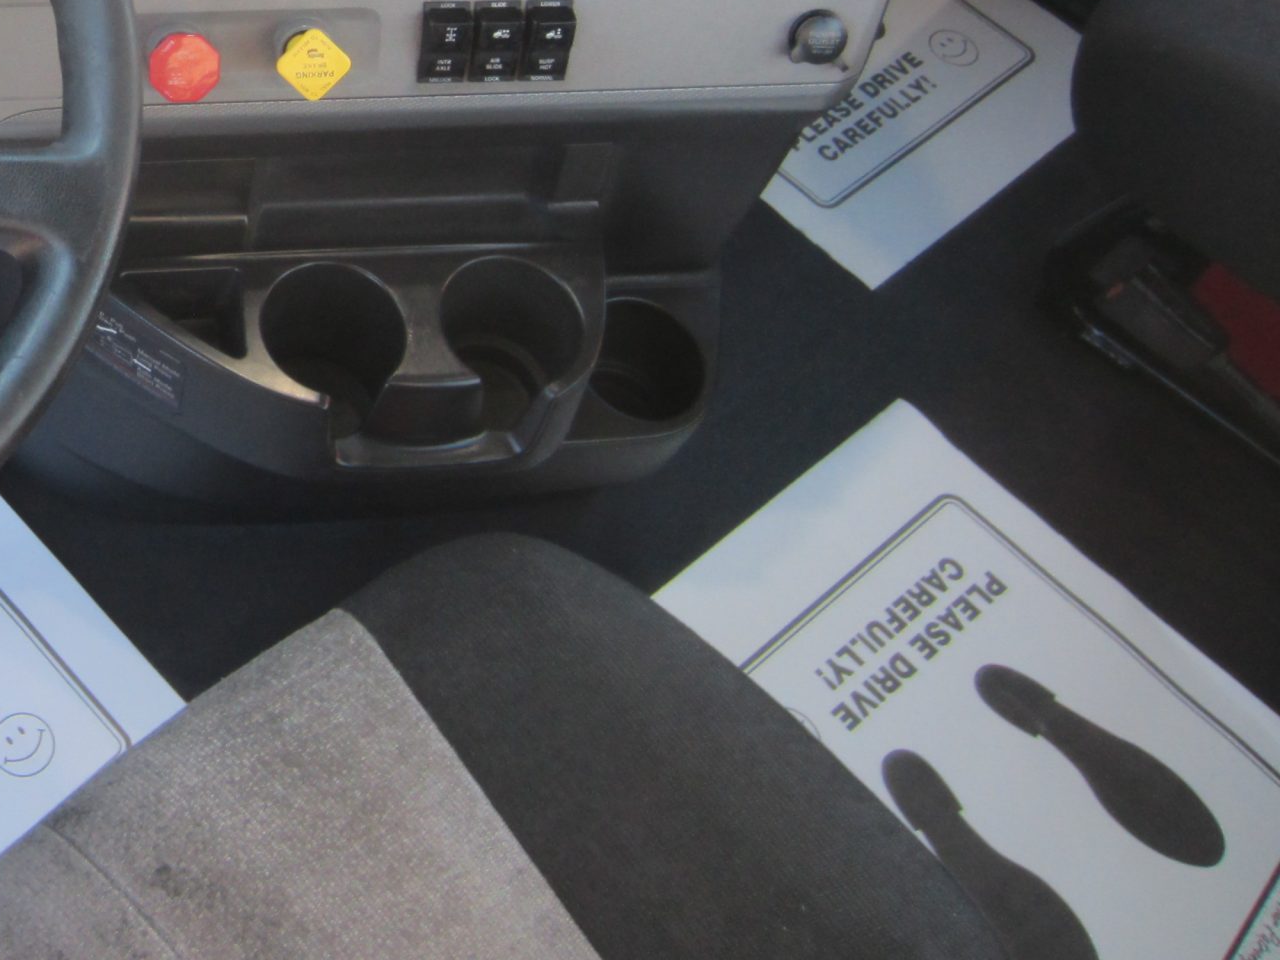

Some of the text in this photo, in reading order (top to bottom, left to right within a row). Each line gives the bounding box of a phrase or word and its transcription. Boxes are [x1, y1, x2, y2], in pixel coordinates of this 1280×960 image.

[295, 69, 336, 80] PARKING
[858, 51, 924, 99] DRIVE
[818, 75, 937, 161] CAREFULLY!
[815, 557, 965, 691] CAREFULLY!
[830, 570, 1008, 732] PLEASE DRIVE
